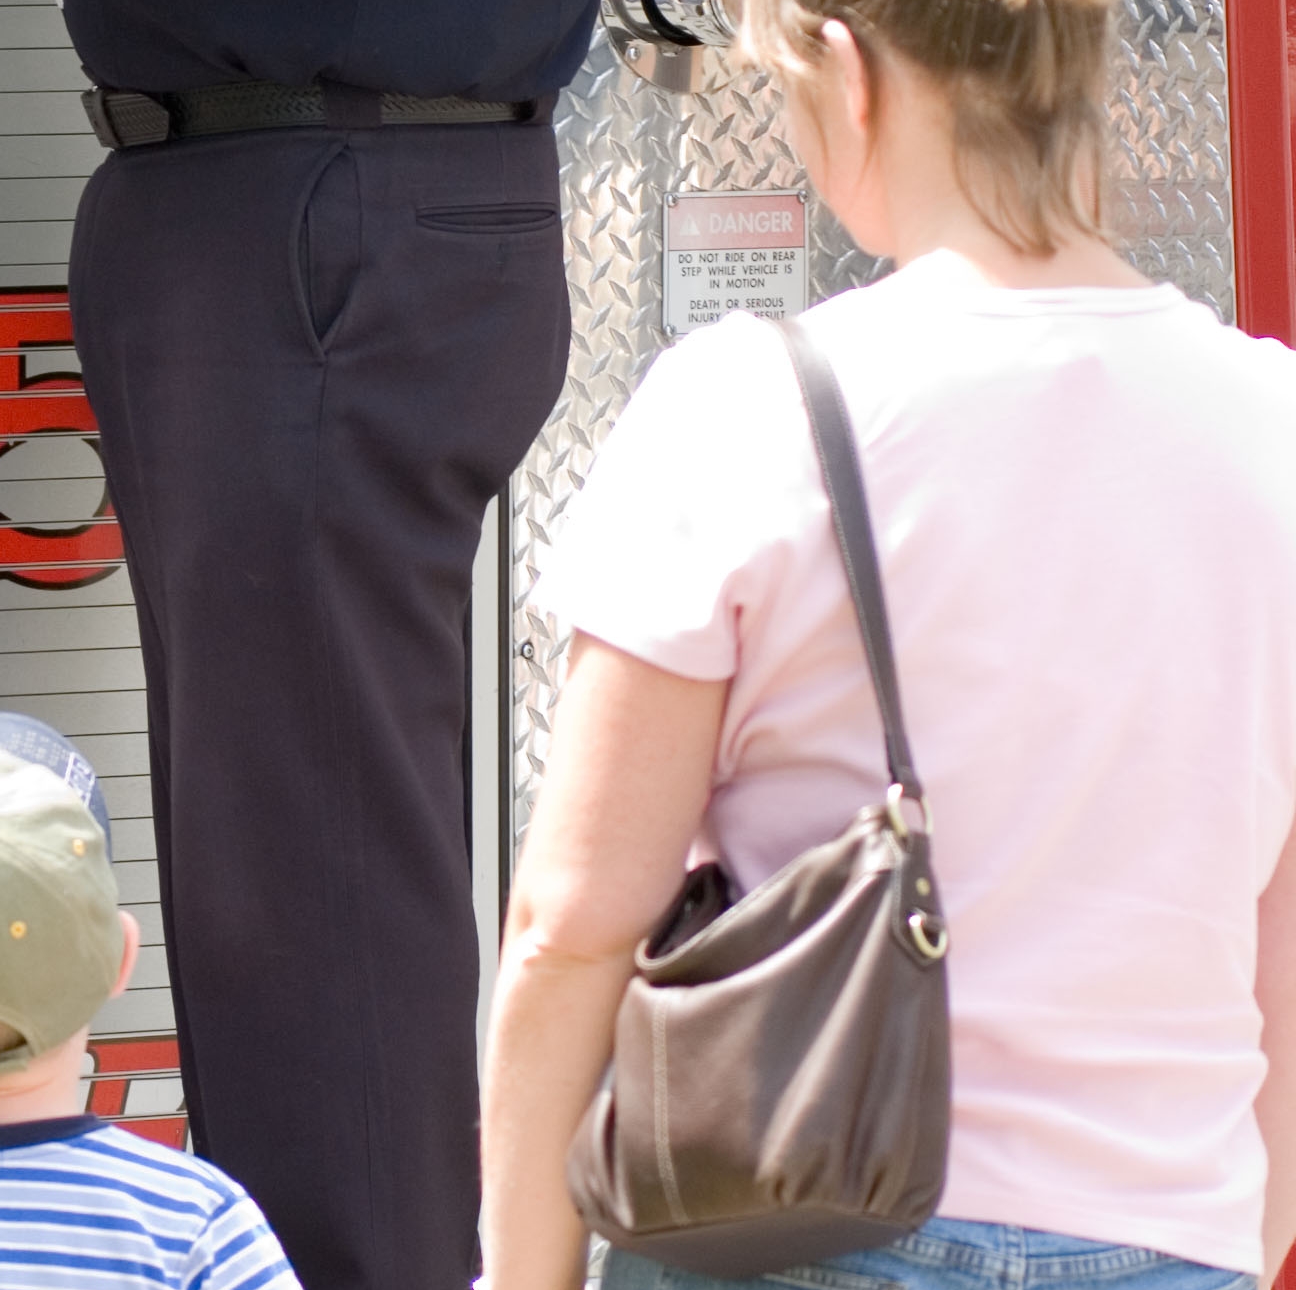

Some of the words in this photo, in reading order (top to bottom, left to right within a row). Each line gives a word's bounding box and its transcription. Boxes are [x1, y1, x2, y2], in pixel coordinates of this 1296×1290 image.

[709, 211, 793, 234] DANGER
[678, 254, 693, 264] DO
[699, 253, 719, 263] NOT
[725, 252, 745, 262] RIDE
[751, 252, 766, 262] ON
[772, 251, 796, 261] REAR
[681, 266, 702, 277] STEP
[707, 265, 736, 276] WHILE
[742, 264, 779, 275] VEHICLE
[784, 264, 793, 274] IS
[709, 279, 720, 289] IN
[726, 278, 765, 288] MOTION
[689, 299, 720, 310] DEATH
[726, 298, 740, 309] OR
[745, 297, 784, 308] SERIOUS
[687, 312, 721, 323] INJURY
